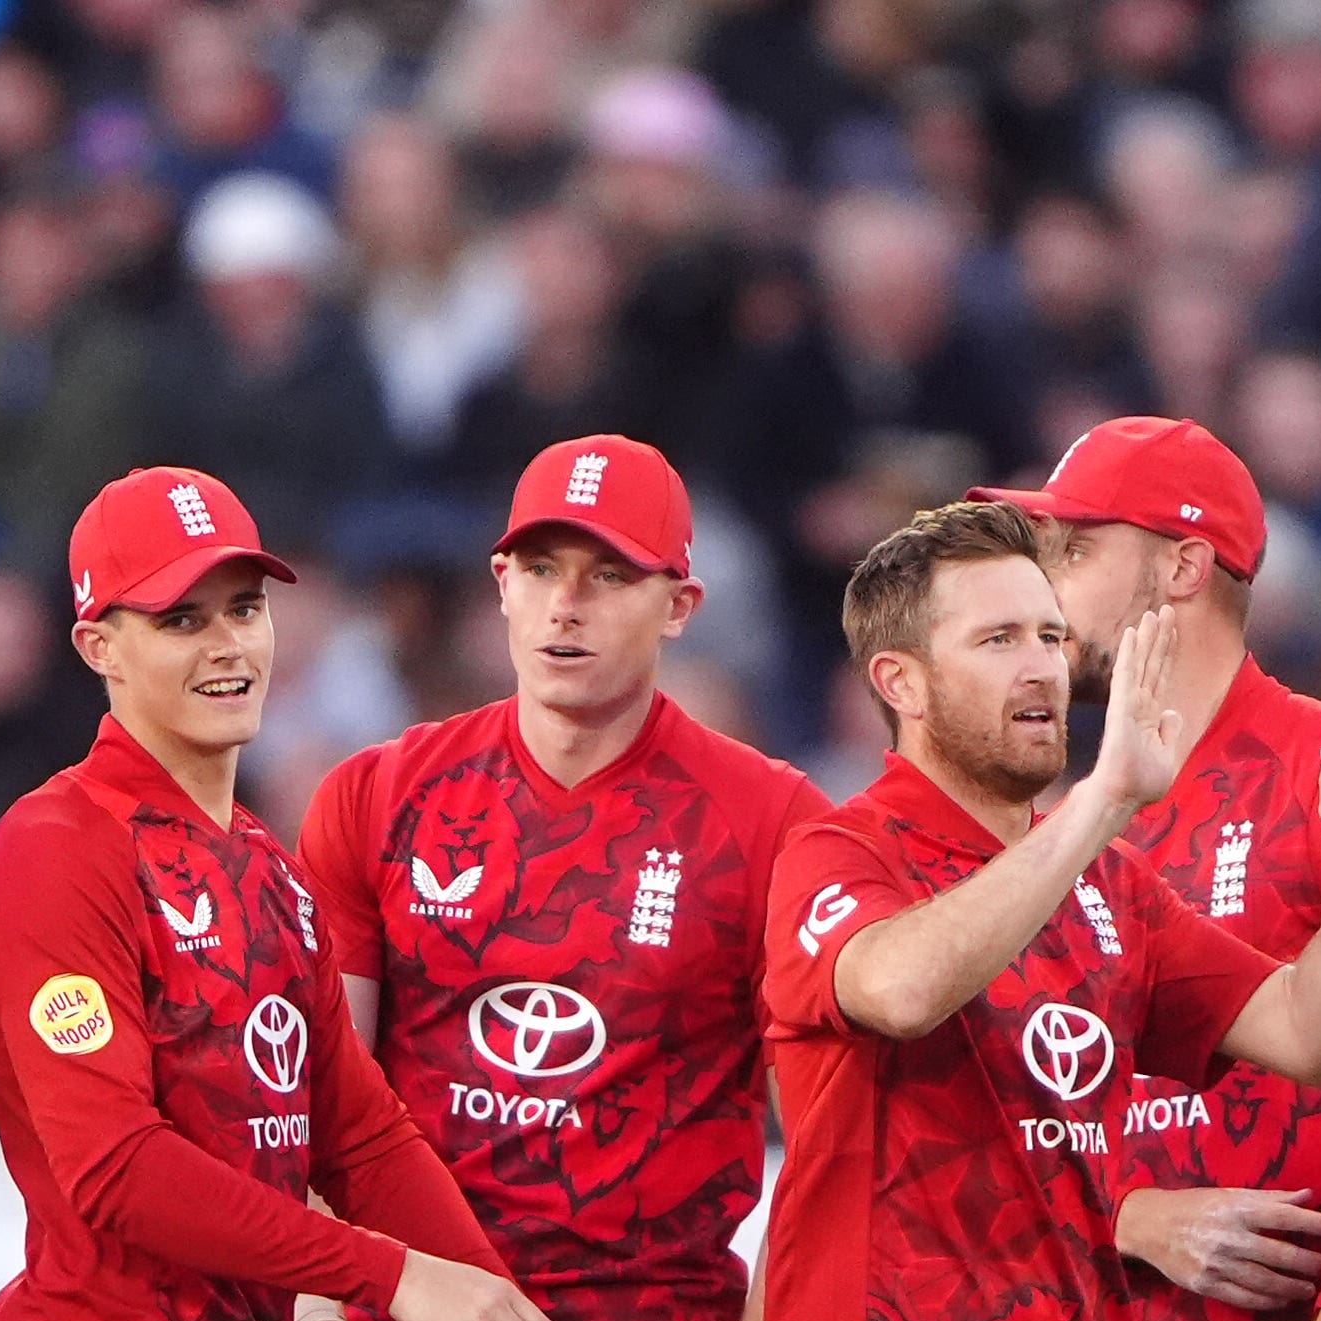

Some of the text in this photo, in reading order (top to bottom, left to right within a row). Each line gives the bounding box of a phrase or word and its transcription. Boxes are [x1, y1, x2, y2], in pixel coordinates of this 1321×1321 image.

[1180, 503, 1203, 521] 97
[409, 902, 473, 920] CASTORE
[798, 882, 859, 957] IG
[45, 989, 88, 1023] HULA
[52, 1009, 105, 1045] HOOPS
[448, 1082, 583, 1128] TOYOTA
[1123, 1094, 1211, 1136] YOTA
